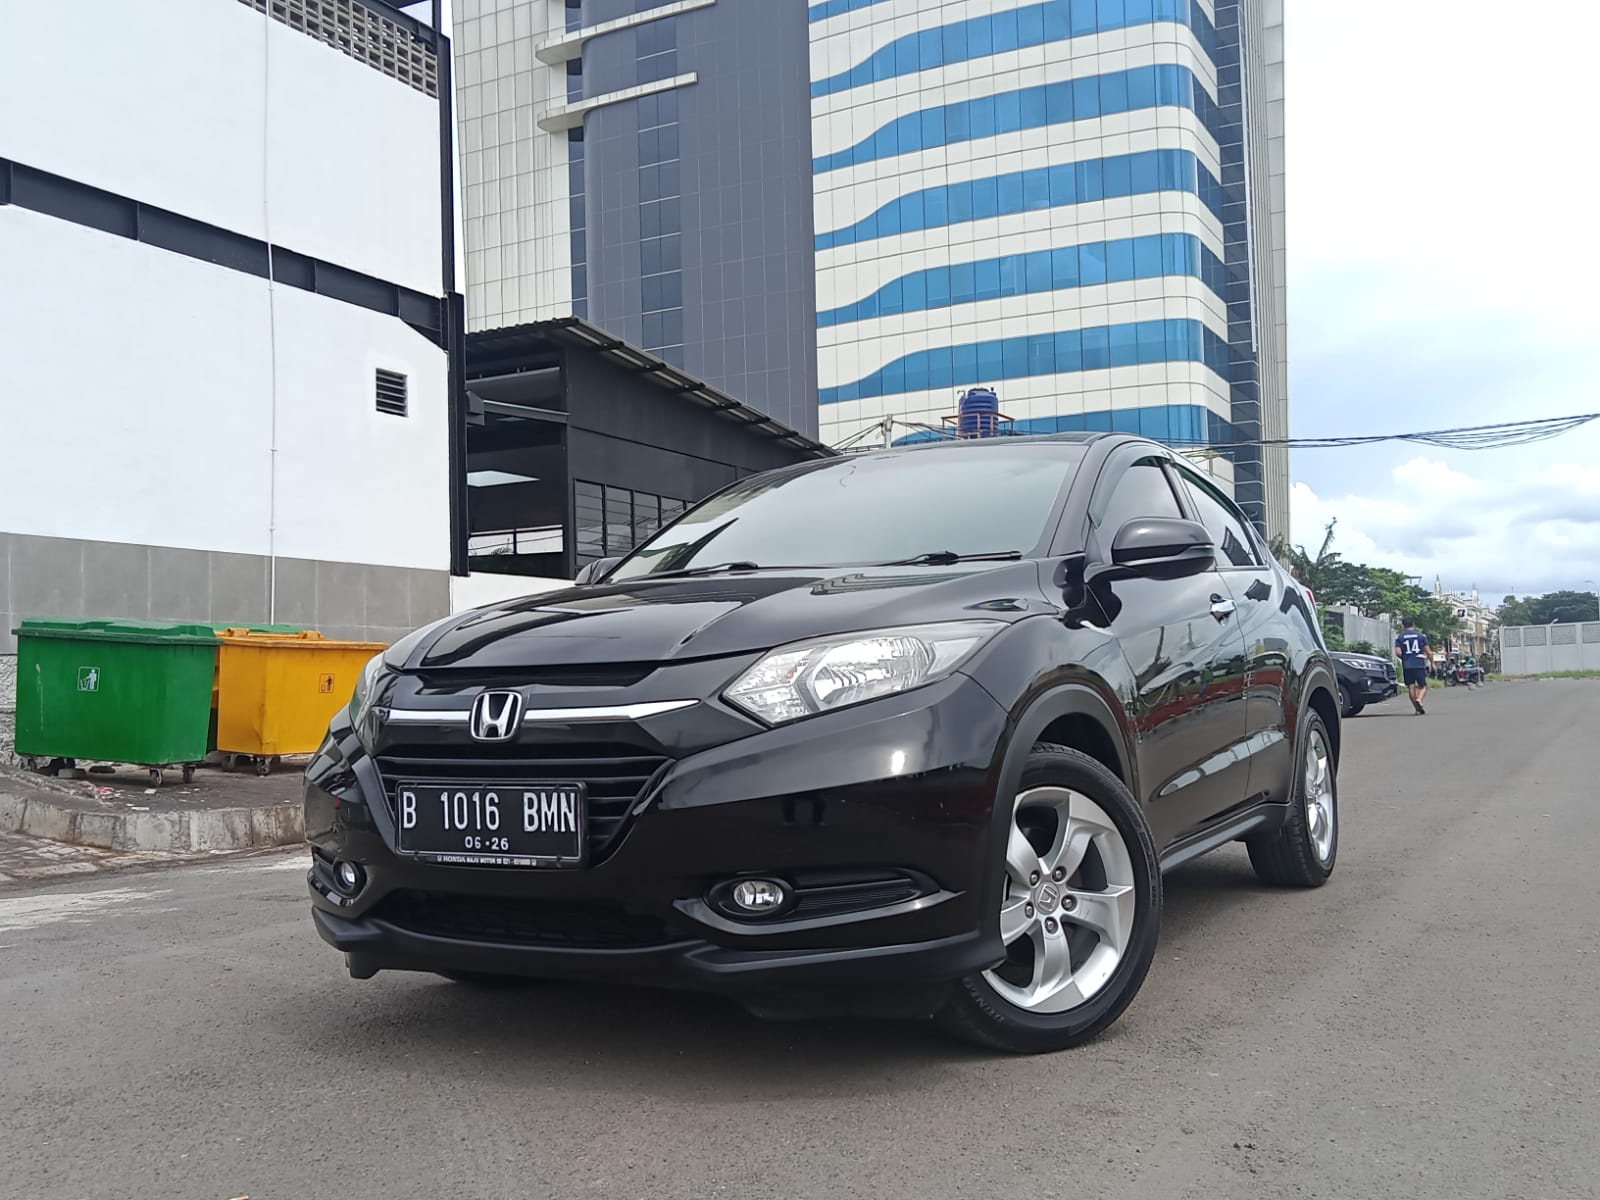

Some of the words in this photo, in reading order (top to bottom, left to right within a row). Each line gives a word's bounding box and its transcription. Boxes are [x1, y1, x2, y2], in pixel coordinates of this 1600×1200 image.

[1403, 639, 1421, 654] 14
[402, 791, 417, 829] B
[440, 791, 500, 831] 1016
[523, 792, 577, 832] BMN
[443, 855, 466, 863] HONDA
[962, 976, 1005, 1024] DUNLO
